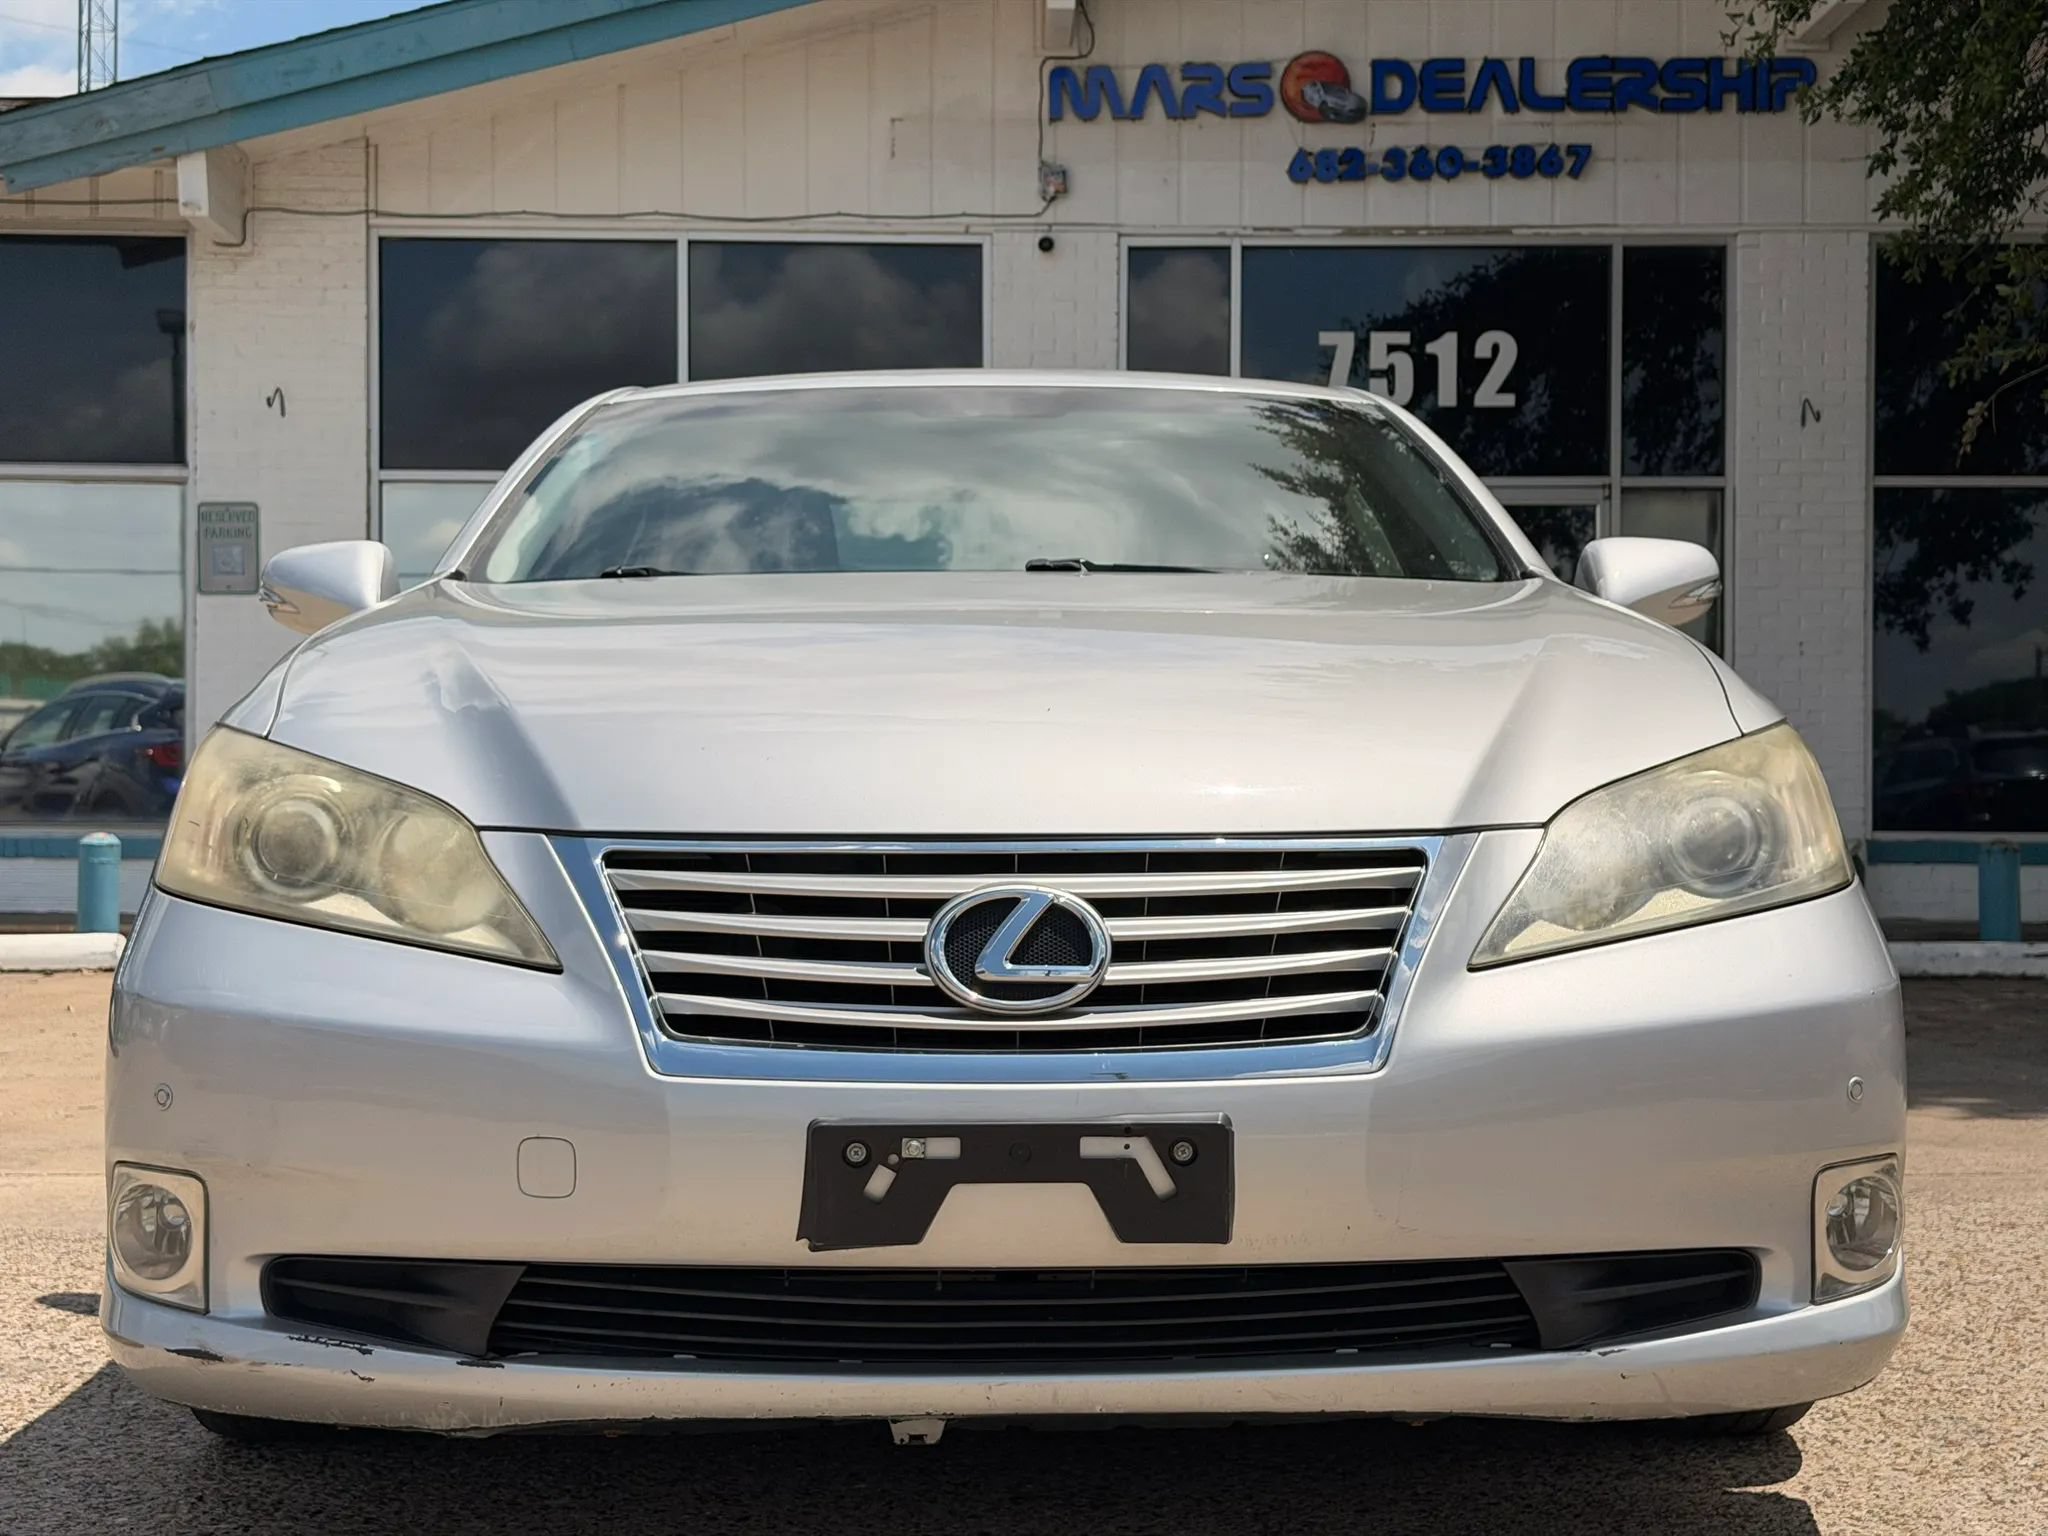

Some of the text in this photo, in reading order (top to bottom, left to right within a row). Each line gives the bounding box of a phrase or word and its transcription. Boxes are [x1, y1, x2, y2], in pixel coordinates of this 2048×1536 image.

[1049, 55, 1818, 122] MARS DEALERSHIP
[1287, 144, 1593, 184] 682-360-3867
[1318, 329, 1518, 408] 7512
[204, 527, 253, 539] PARKING
